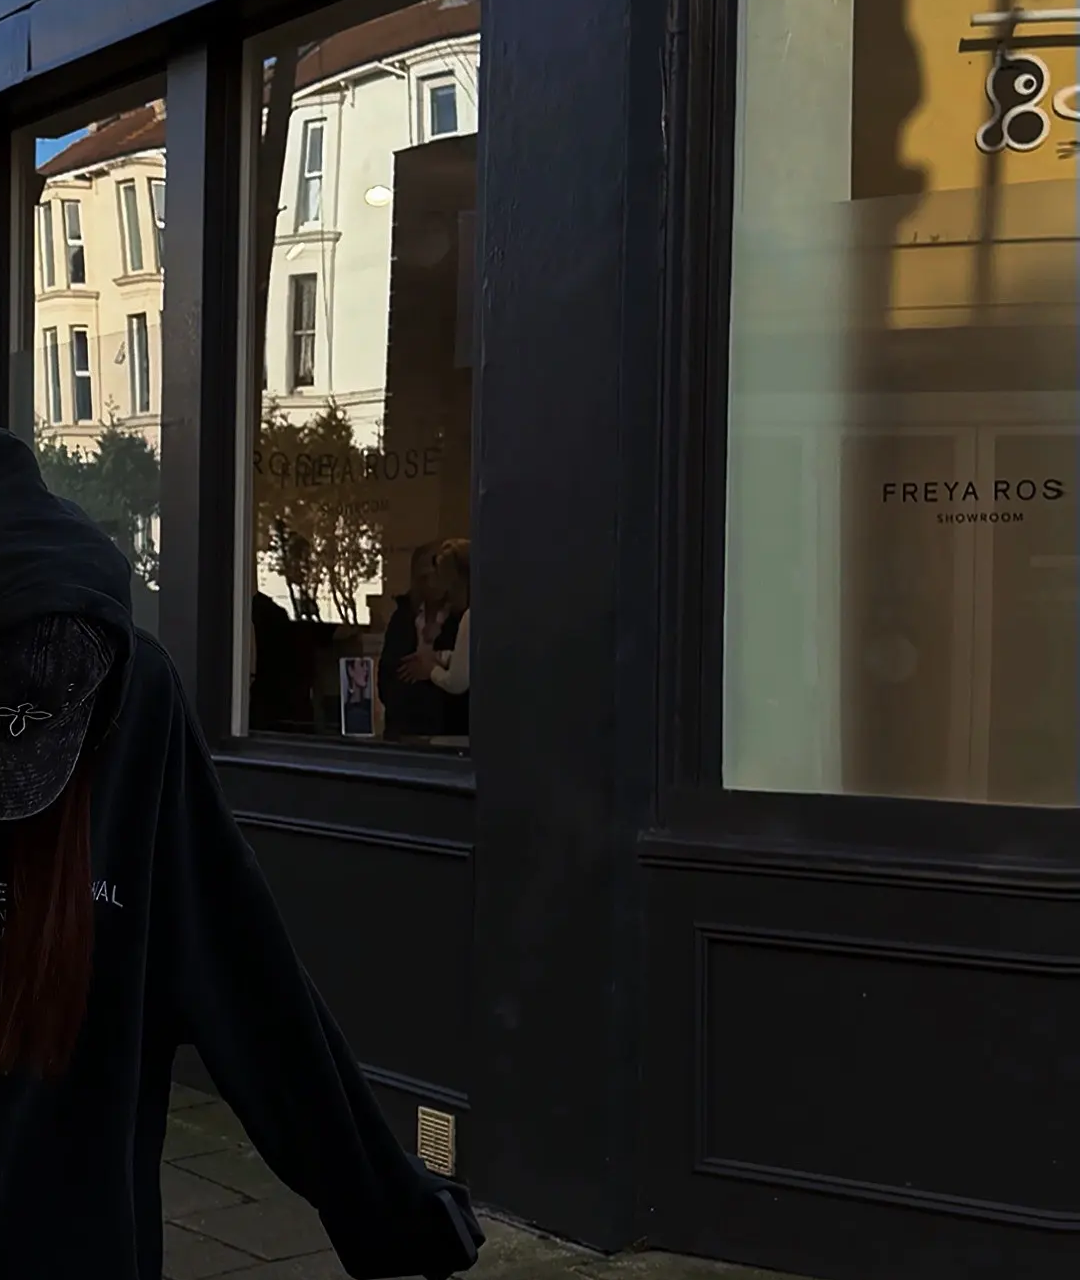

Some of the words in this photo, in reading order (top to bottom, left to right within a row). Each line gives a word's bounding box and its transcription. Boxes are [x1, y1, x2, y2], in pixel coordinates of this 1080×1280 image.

[365, 447, 442, 481] ROSE
[883, 481, 979, 503] FREYA
[936, 512, 1024, 524] SHOWROOM
